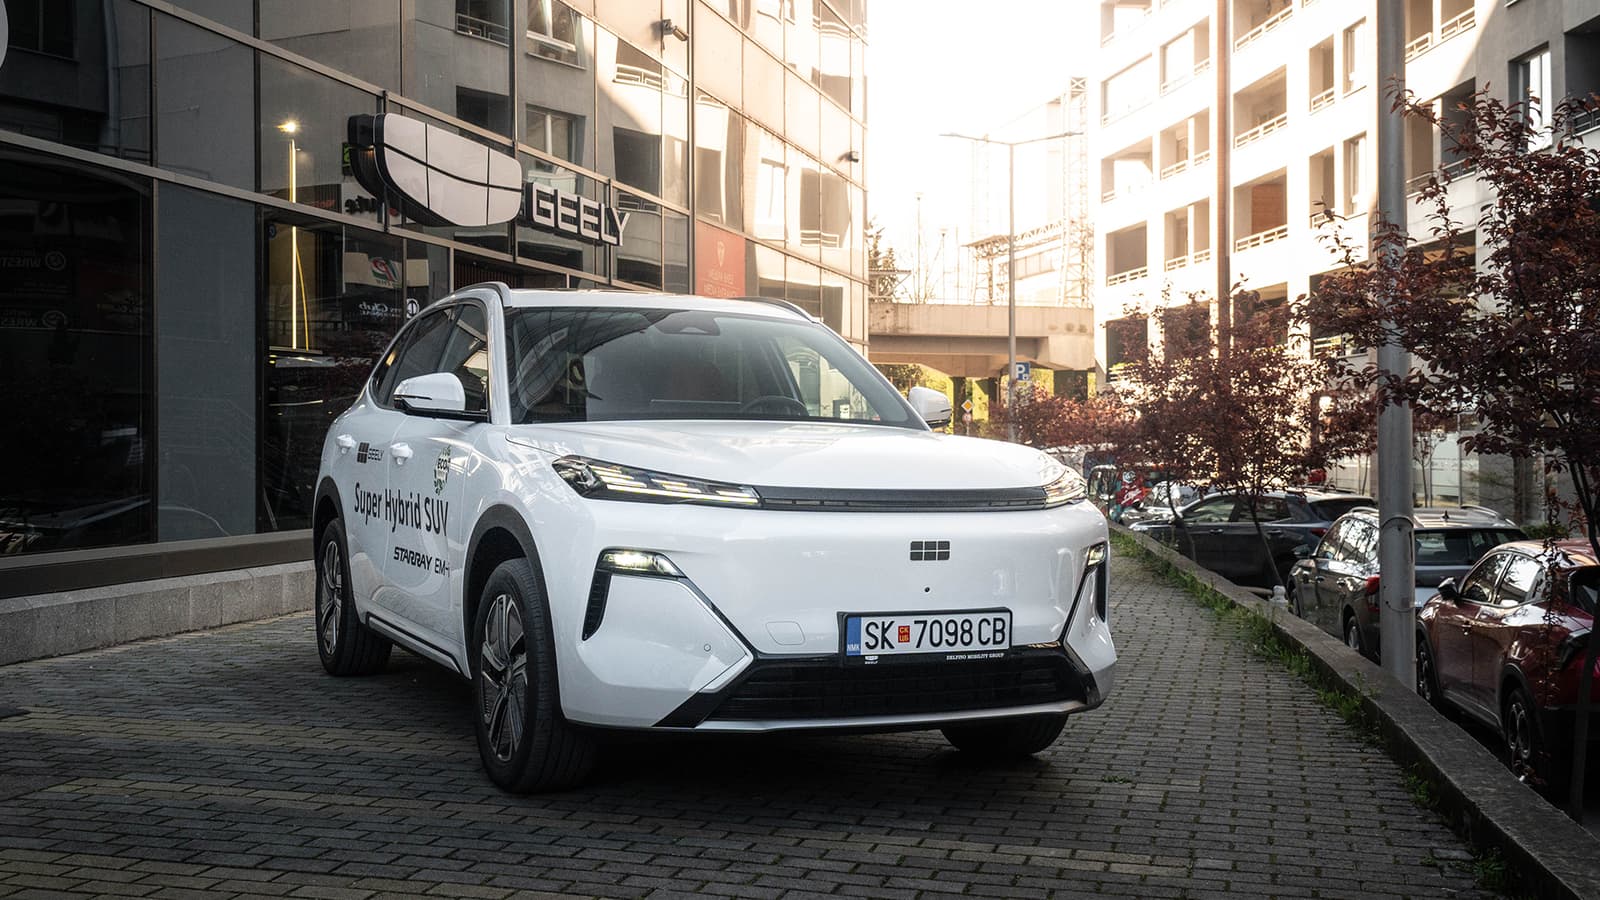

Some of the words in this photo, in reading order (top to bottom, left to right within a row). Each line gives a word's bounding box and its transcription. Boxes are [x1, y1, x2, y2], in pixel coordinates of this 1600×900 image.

[530, 182, 631, 246] GEELY
[354, 482, 382, 525] Super
[385, 489, 422, 533] Hybrid
[424, 497, 449, 537] SUV
[393, 546, 433, 571] STARRAY
[864, 620, 895, 650] SK
